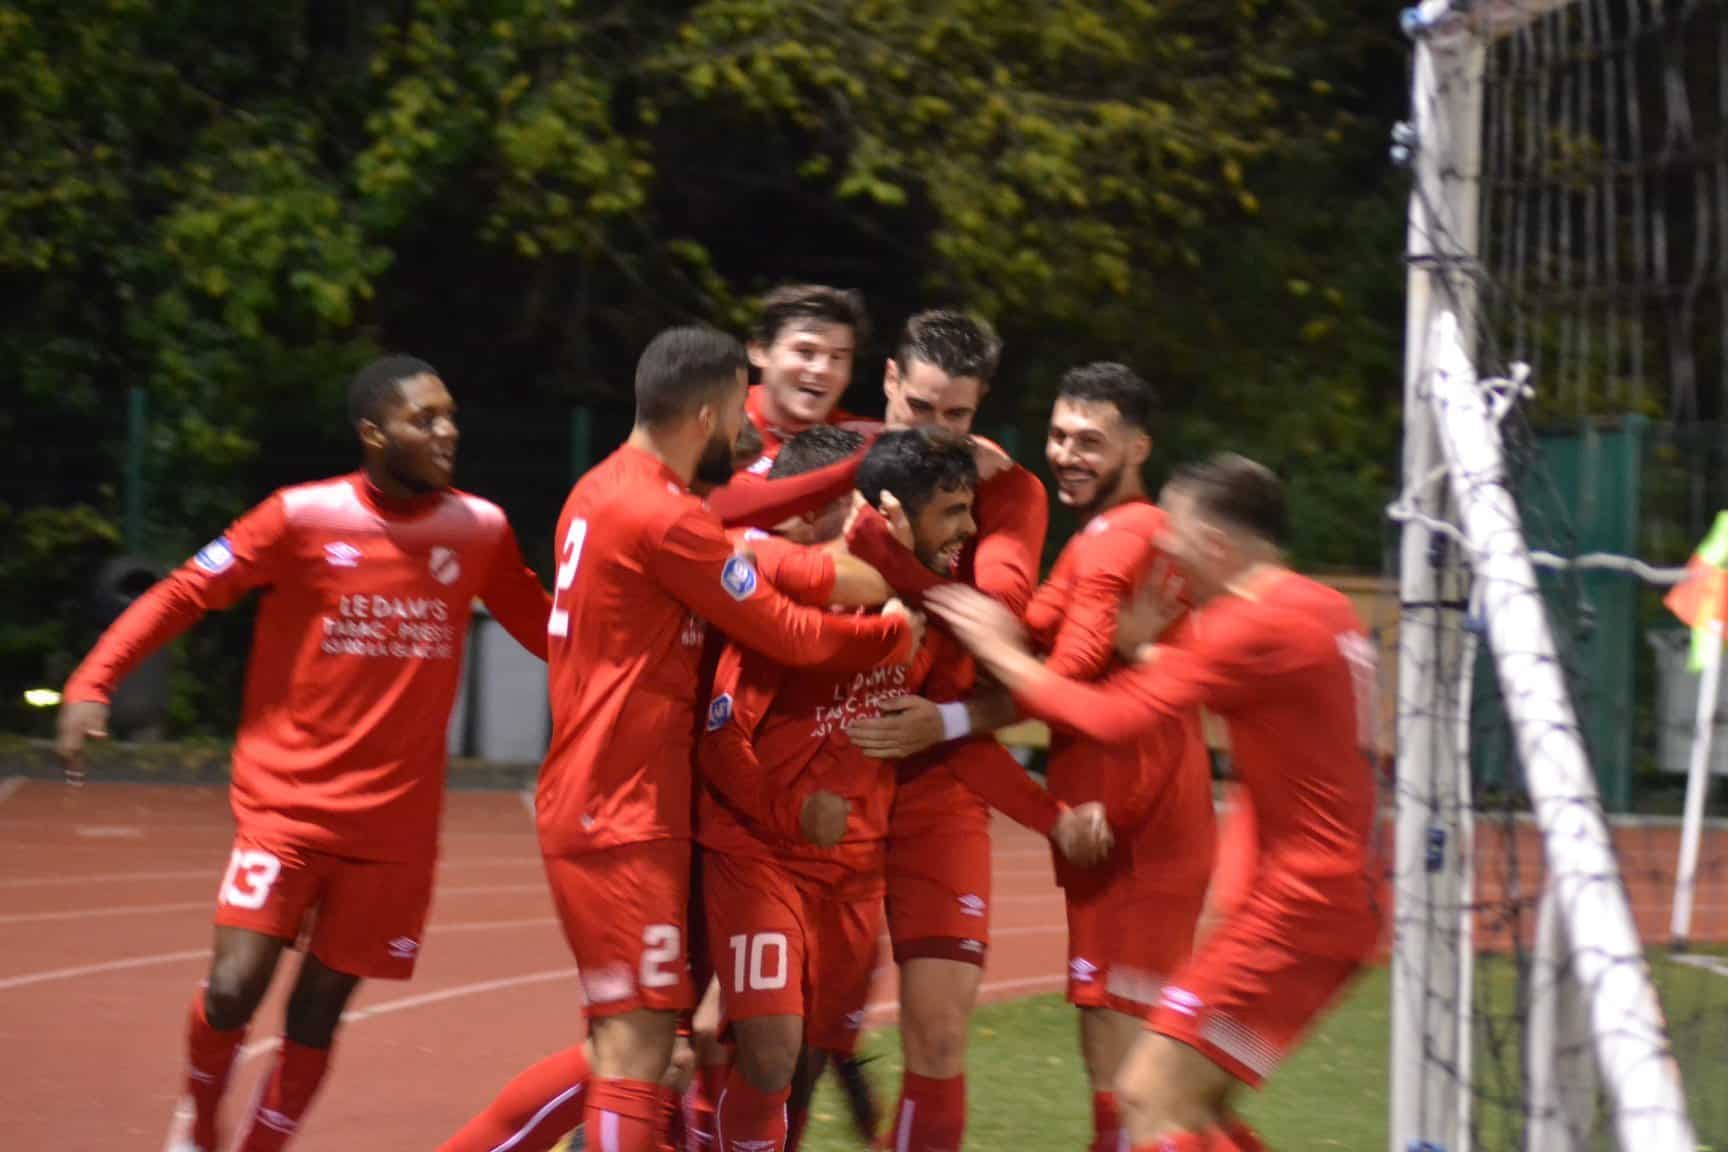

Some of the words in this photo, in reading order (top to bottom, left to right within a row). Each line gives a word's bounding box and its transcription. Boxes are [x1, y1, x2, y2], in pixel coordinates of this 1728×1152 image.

[547, 517, 587, 638] 2
[217, 848, 281, 910] 13
[640, 924, 681, 987] 2
[729, 932, 788, 993] 10
